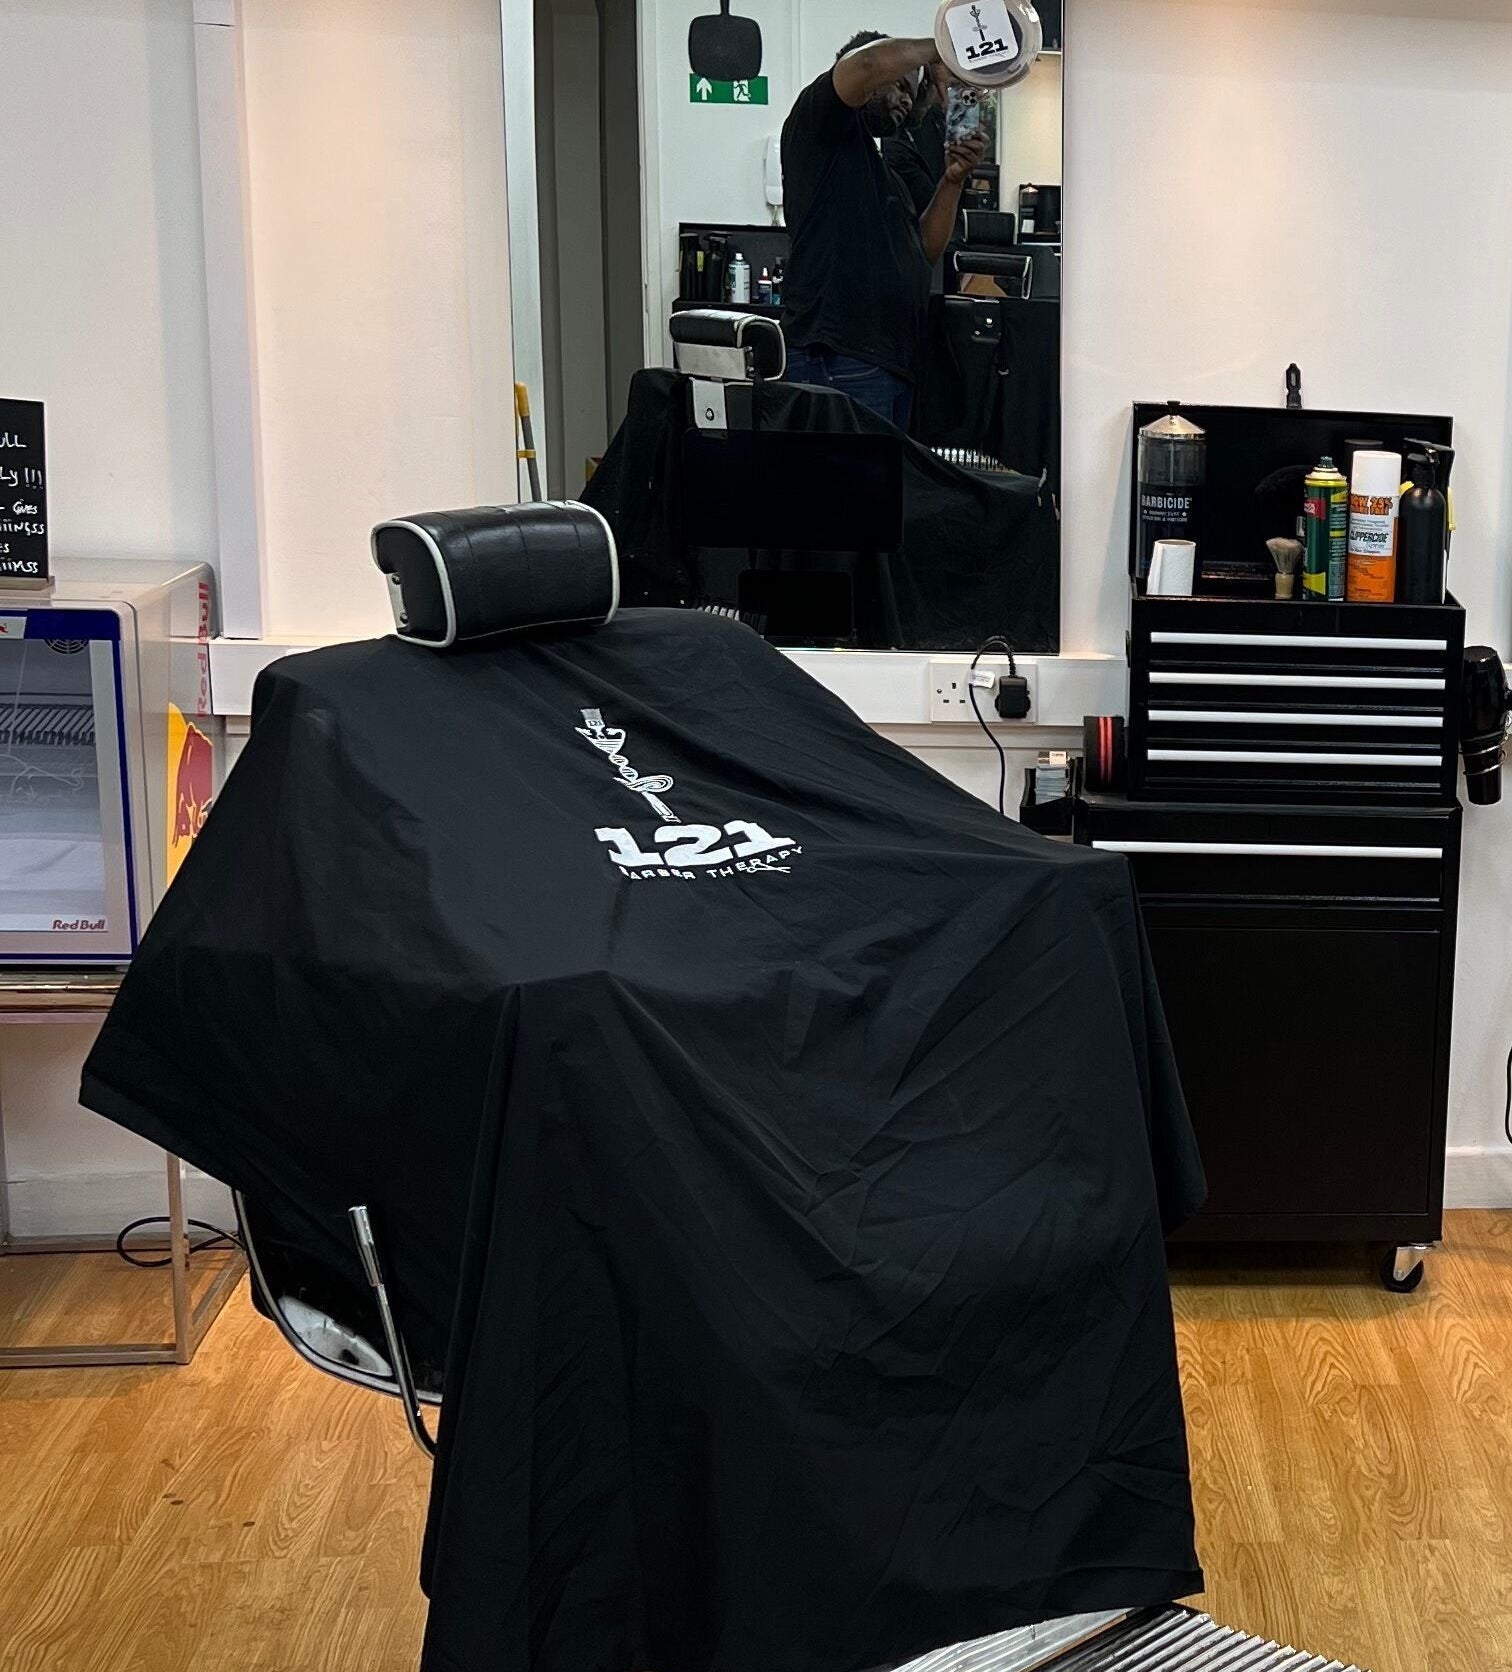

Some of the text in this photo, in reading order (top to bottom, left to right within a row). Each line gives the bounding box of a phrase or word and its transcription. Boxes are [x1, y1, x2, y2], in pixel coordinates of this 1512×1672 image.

[966, 38, 1008, 60] 121
[1141, 494, 1190, 509] BARBICIDE
[594, 819, 796, 867] 121
[705, 846, 803, 879] THERAPY
[52, 919, 105, 930] Red Bull
